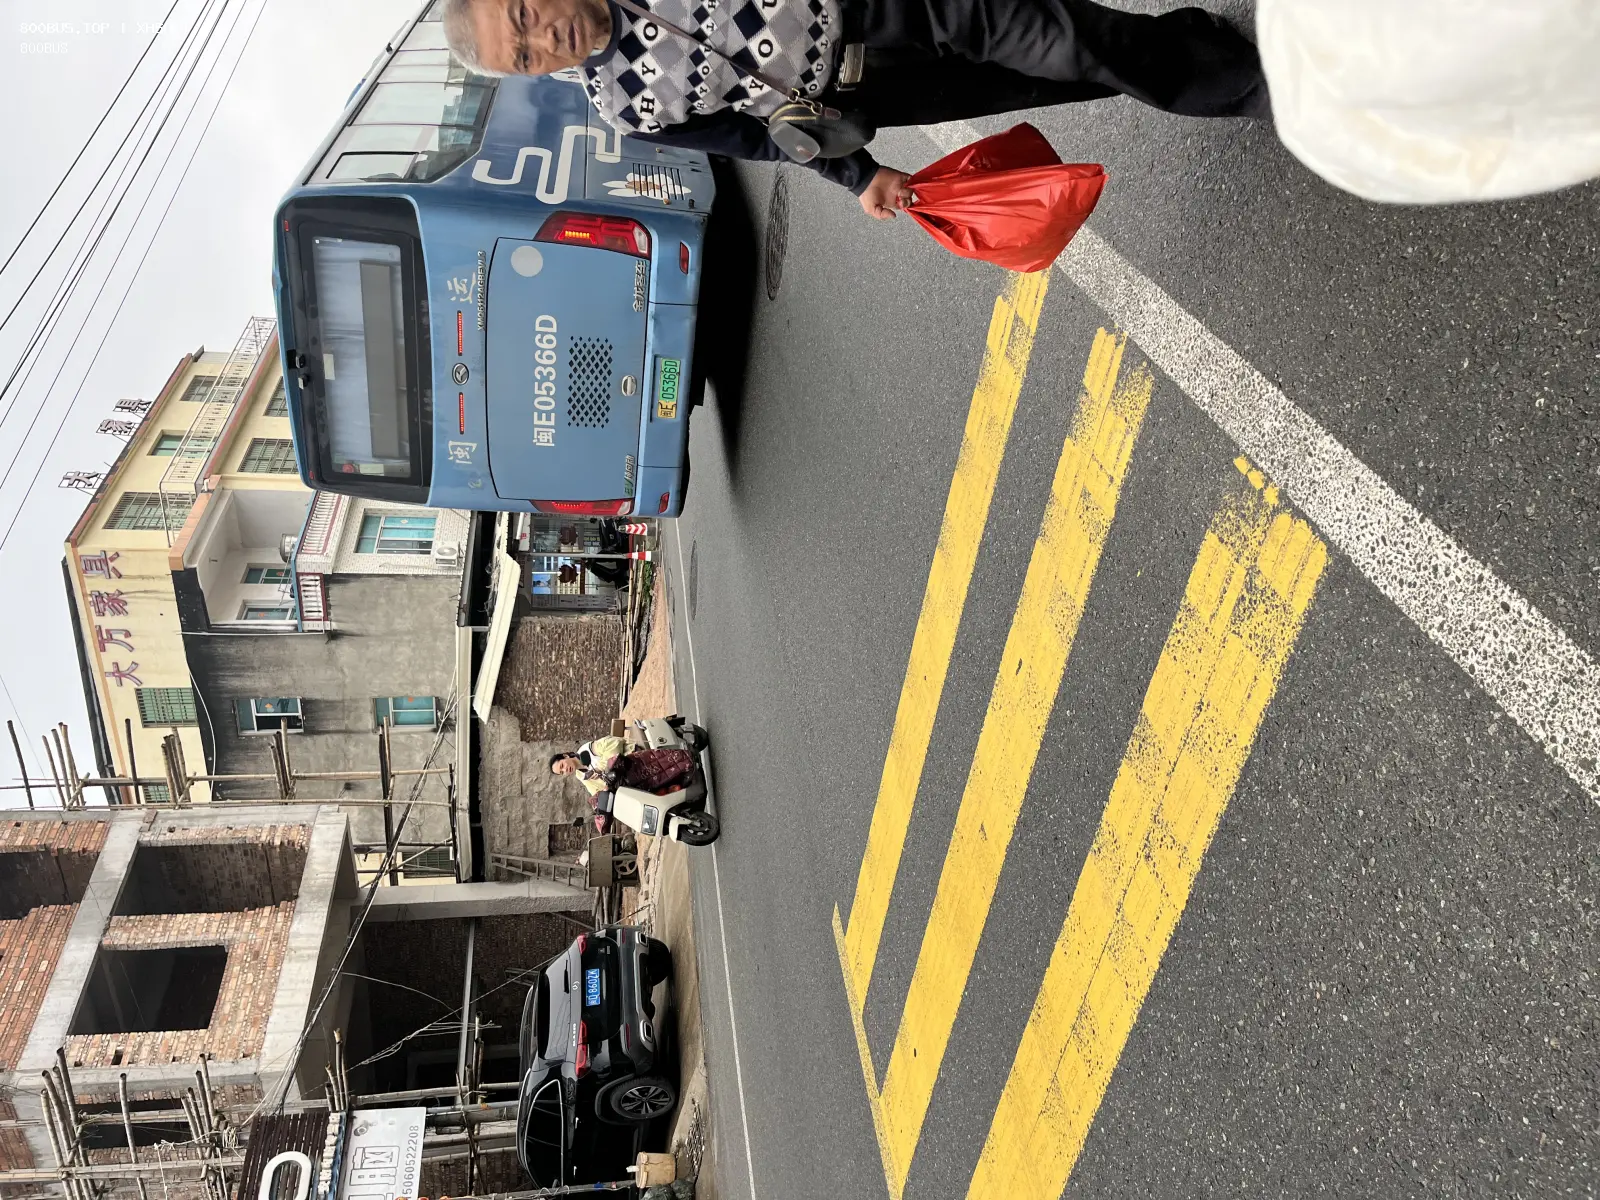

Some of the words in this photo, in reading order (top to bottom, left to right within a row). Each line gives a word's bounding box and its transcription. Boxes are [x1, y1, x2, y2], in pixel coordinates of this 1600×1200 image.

[446, 272, 477, 304] 运
[632, 259, 646, 312] 金龙客车
[532, 315, 557, 447] 闽E05366D
[447, 440, 477, 464] 闽
[80, 550, 143, 687] 大万家具
